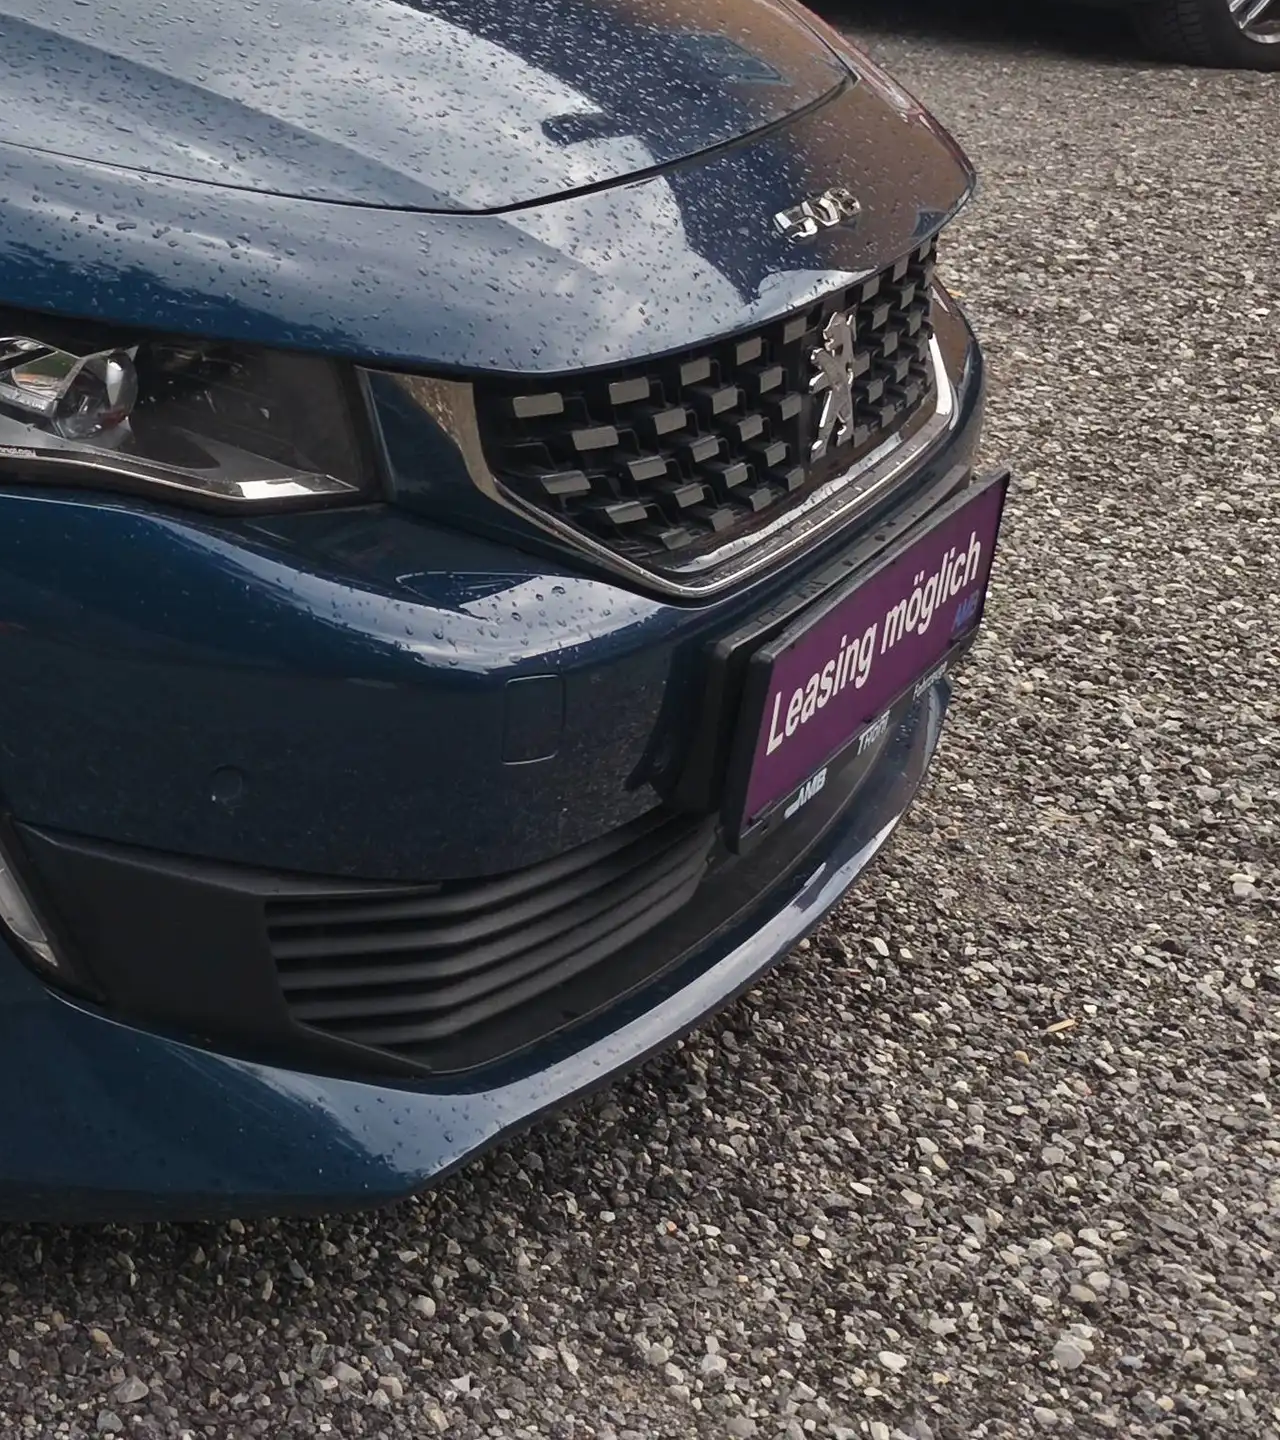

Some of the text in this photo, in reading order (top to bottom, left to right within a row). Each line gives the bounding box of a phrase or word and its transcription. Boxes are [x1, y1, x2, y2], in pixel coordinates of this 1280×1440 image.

[773, 187, 861, 237] 508
[766, 531, 981, 756] Leasing möglich
